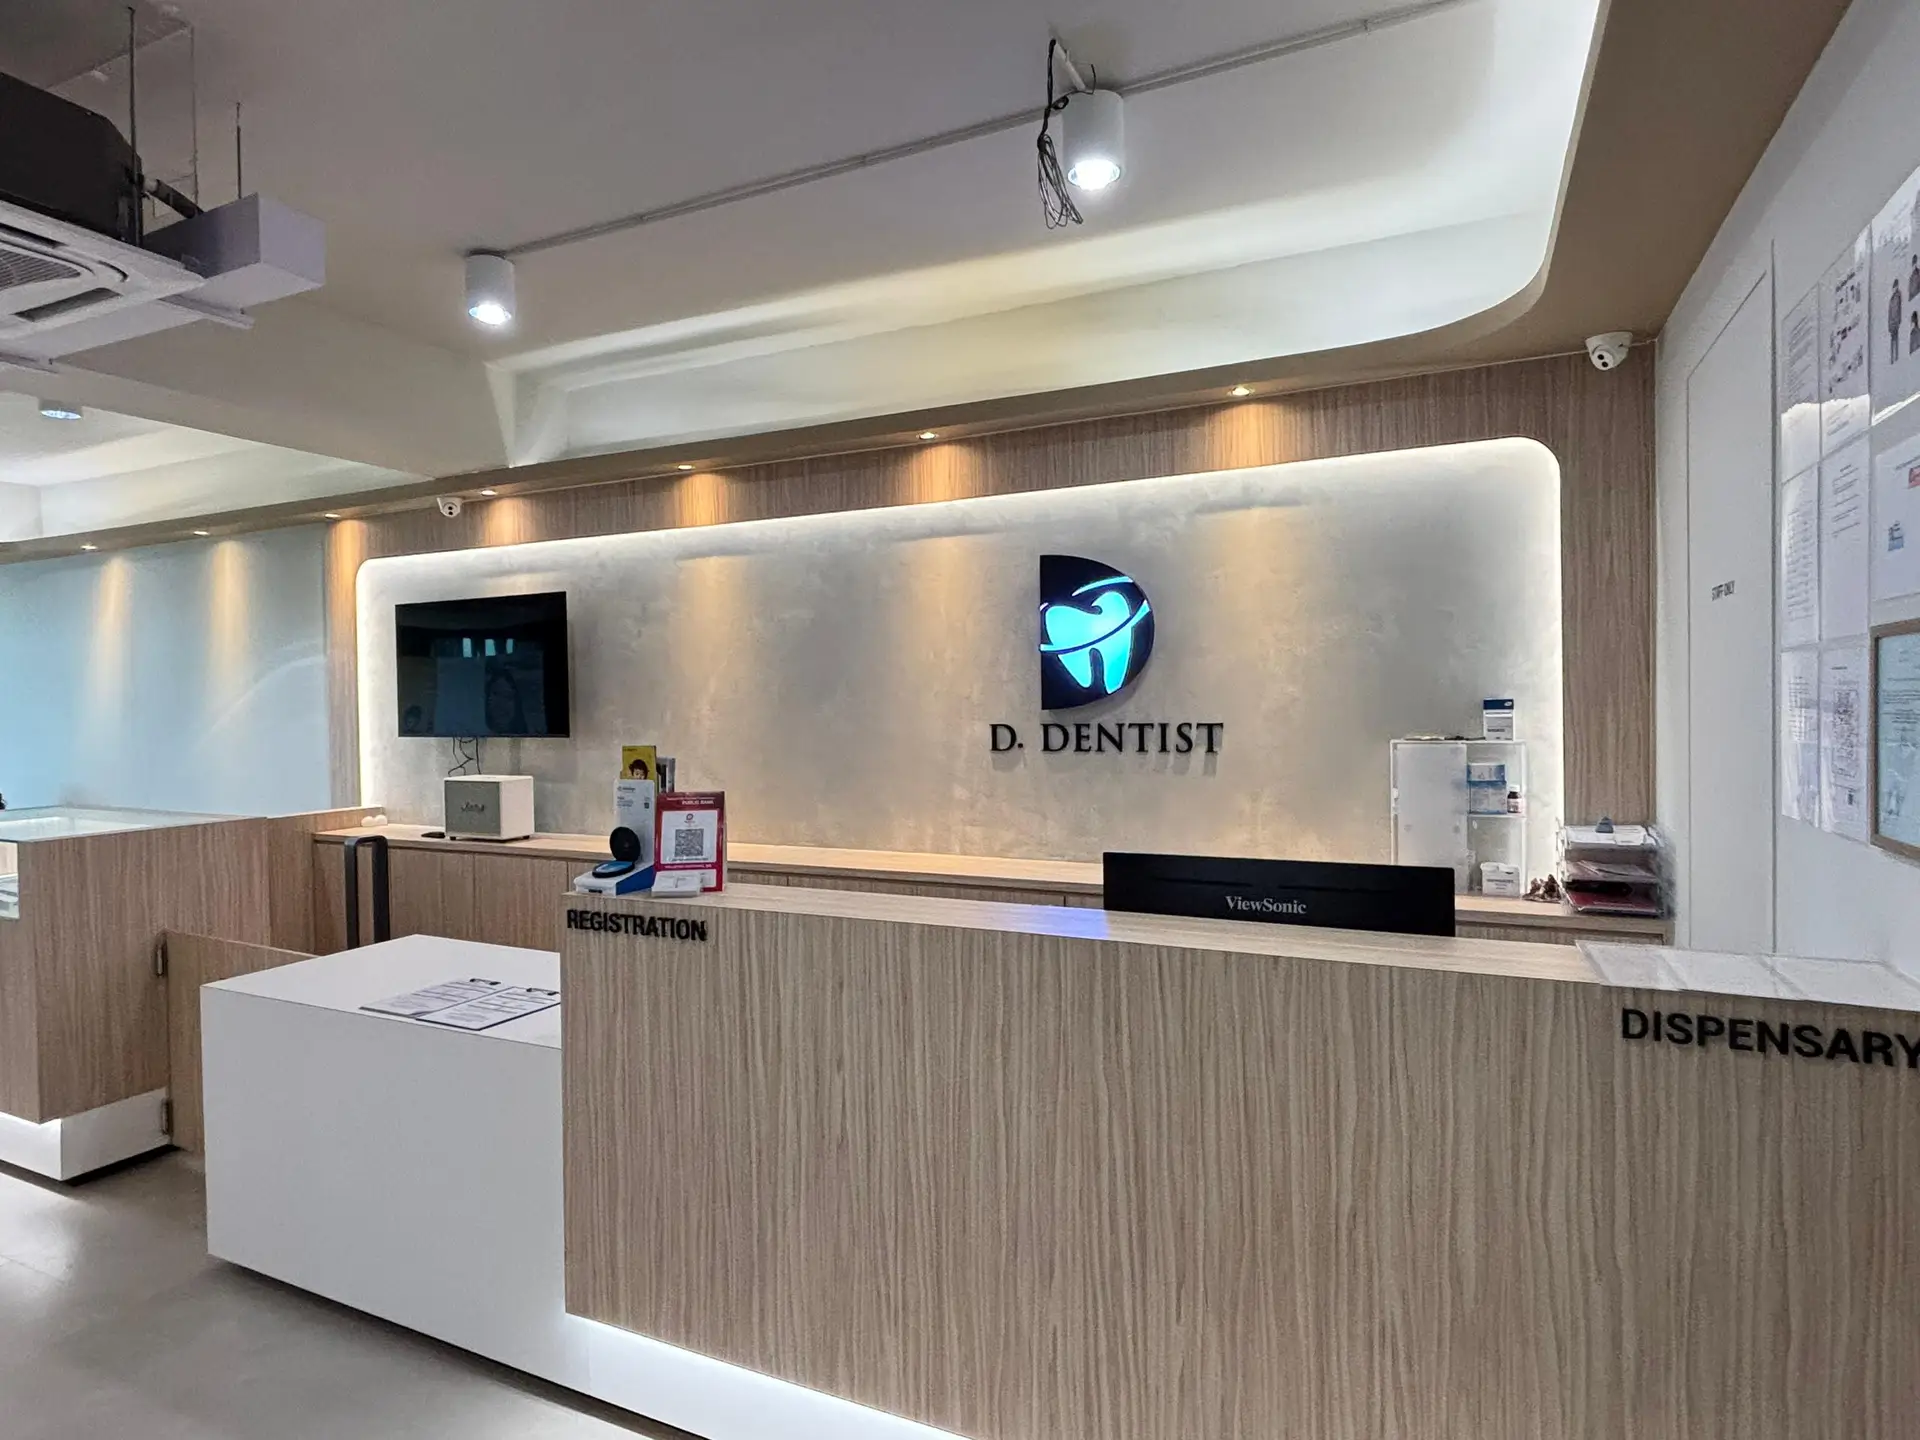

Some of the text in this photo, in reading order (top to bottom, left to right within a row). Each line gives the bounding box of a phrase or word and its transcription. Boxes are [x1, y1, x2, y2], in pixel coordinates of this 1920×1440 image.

[989, 722, 1224, 753] D. DENTIST
[1225, 896, 1307, 914] ViewSonic
[567, 909, 707, 941] REGISTRATION
[1622, 1007, 1920, 1069] DISPENSARY
